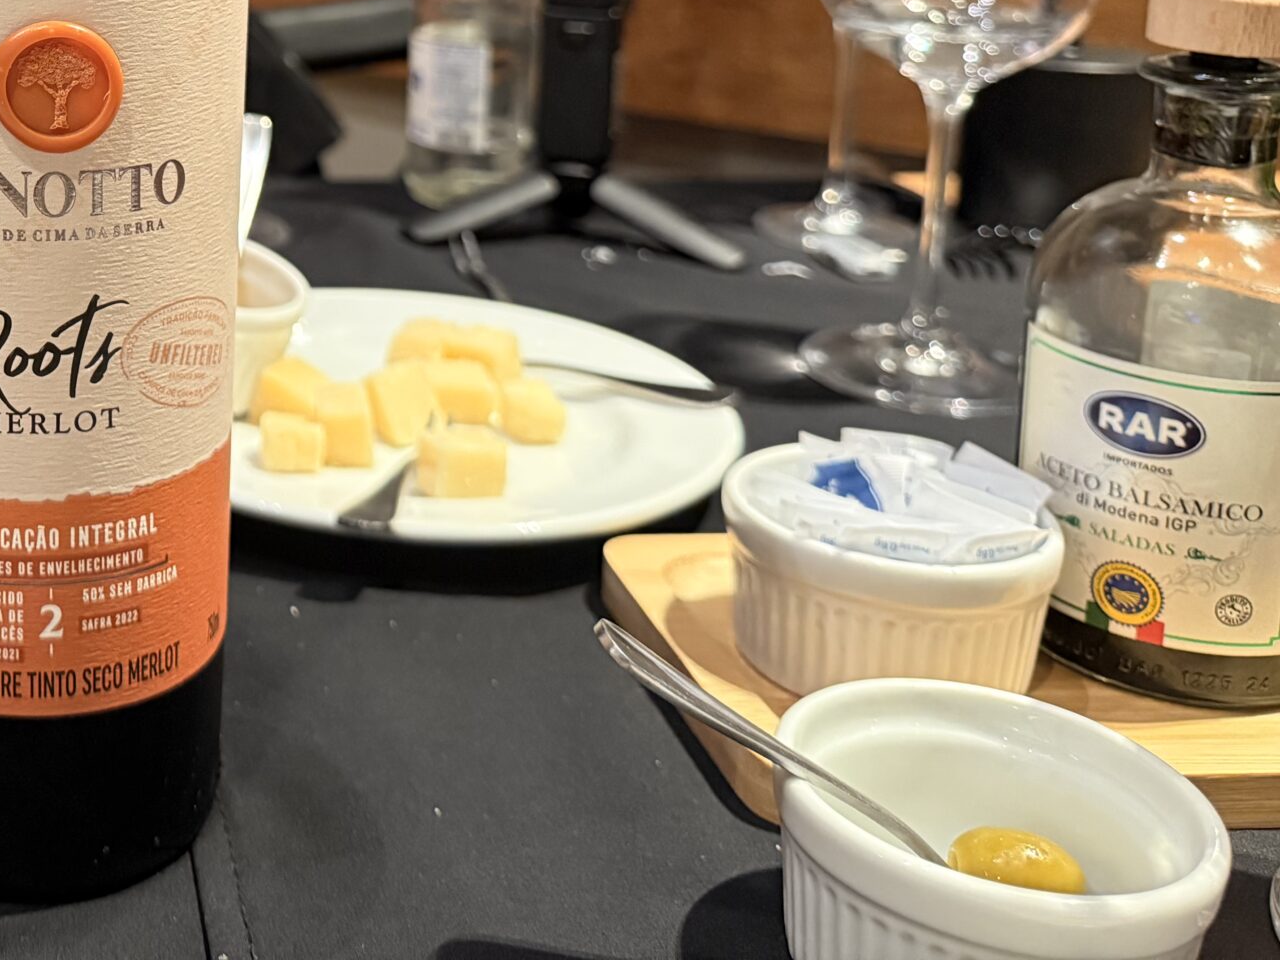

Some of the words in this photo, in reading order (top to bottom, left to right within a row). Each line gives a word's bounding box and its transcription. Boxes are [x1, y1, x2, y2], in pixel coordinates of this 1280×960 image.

[2, 228, 27, 242] DE
[32, 228, 80, 243] CIMA
[85, 225, 108, 241] DA
[112, 216, 166, 238] SERRA
[1098, 400, 1189, 449] RAR
[1103, 452, 1173, 477] IMPORTADOS
[1037, 451, 1101, 492] ACETO
[1108, 478, 1264, 523] BALSAMICO
[70, 512, 158, 549] INTEGRAL
[1076, 492, 1090, 507] di
[1093, 498, 1160, 527] Modena
[1165, 517, 1197, 533] IGP
[1088, 522, 1177, 557] SALADAS
[18, 561, 34, 576] DE
[40, 548, 144, 577] ENVELHECIMENTO
[82, 585, 106, 603] 50%
[109, 580, 132, 598] SEM
[136, 564, 178, 592] BARRICA
[8, 609, 24, 623] DE
[39, 603, 64, 639] 2
[81, 616, 112, 632] SAFRA
[115, 609, 139, 626] 2022
[27, 669, 77, 699] TINTO
[82, 661, 123, 696] SECO
[128, 640, 180, 685] MERLOT
